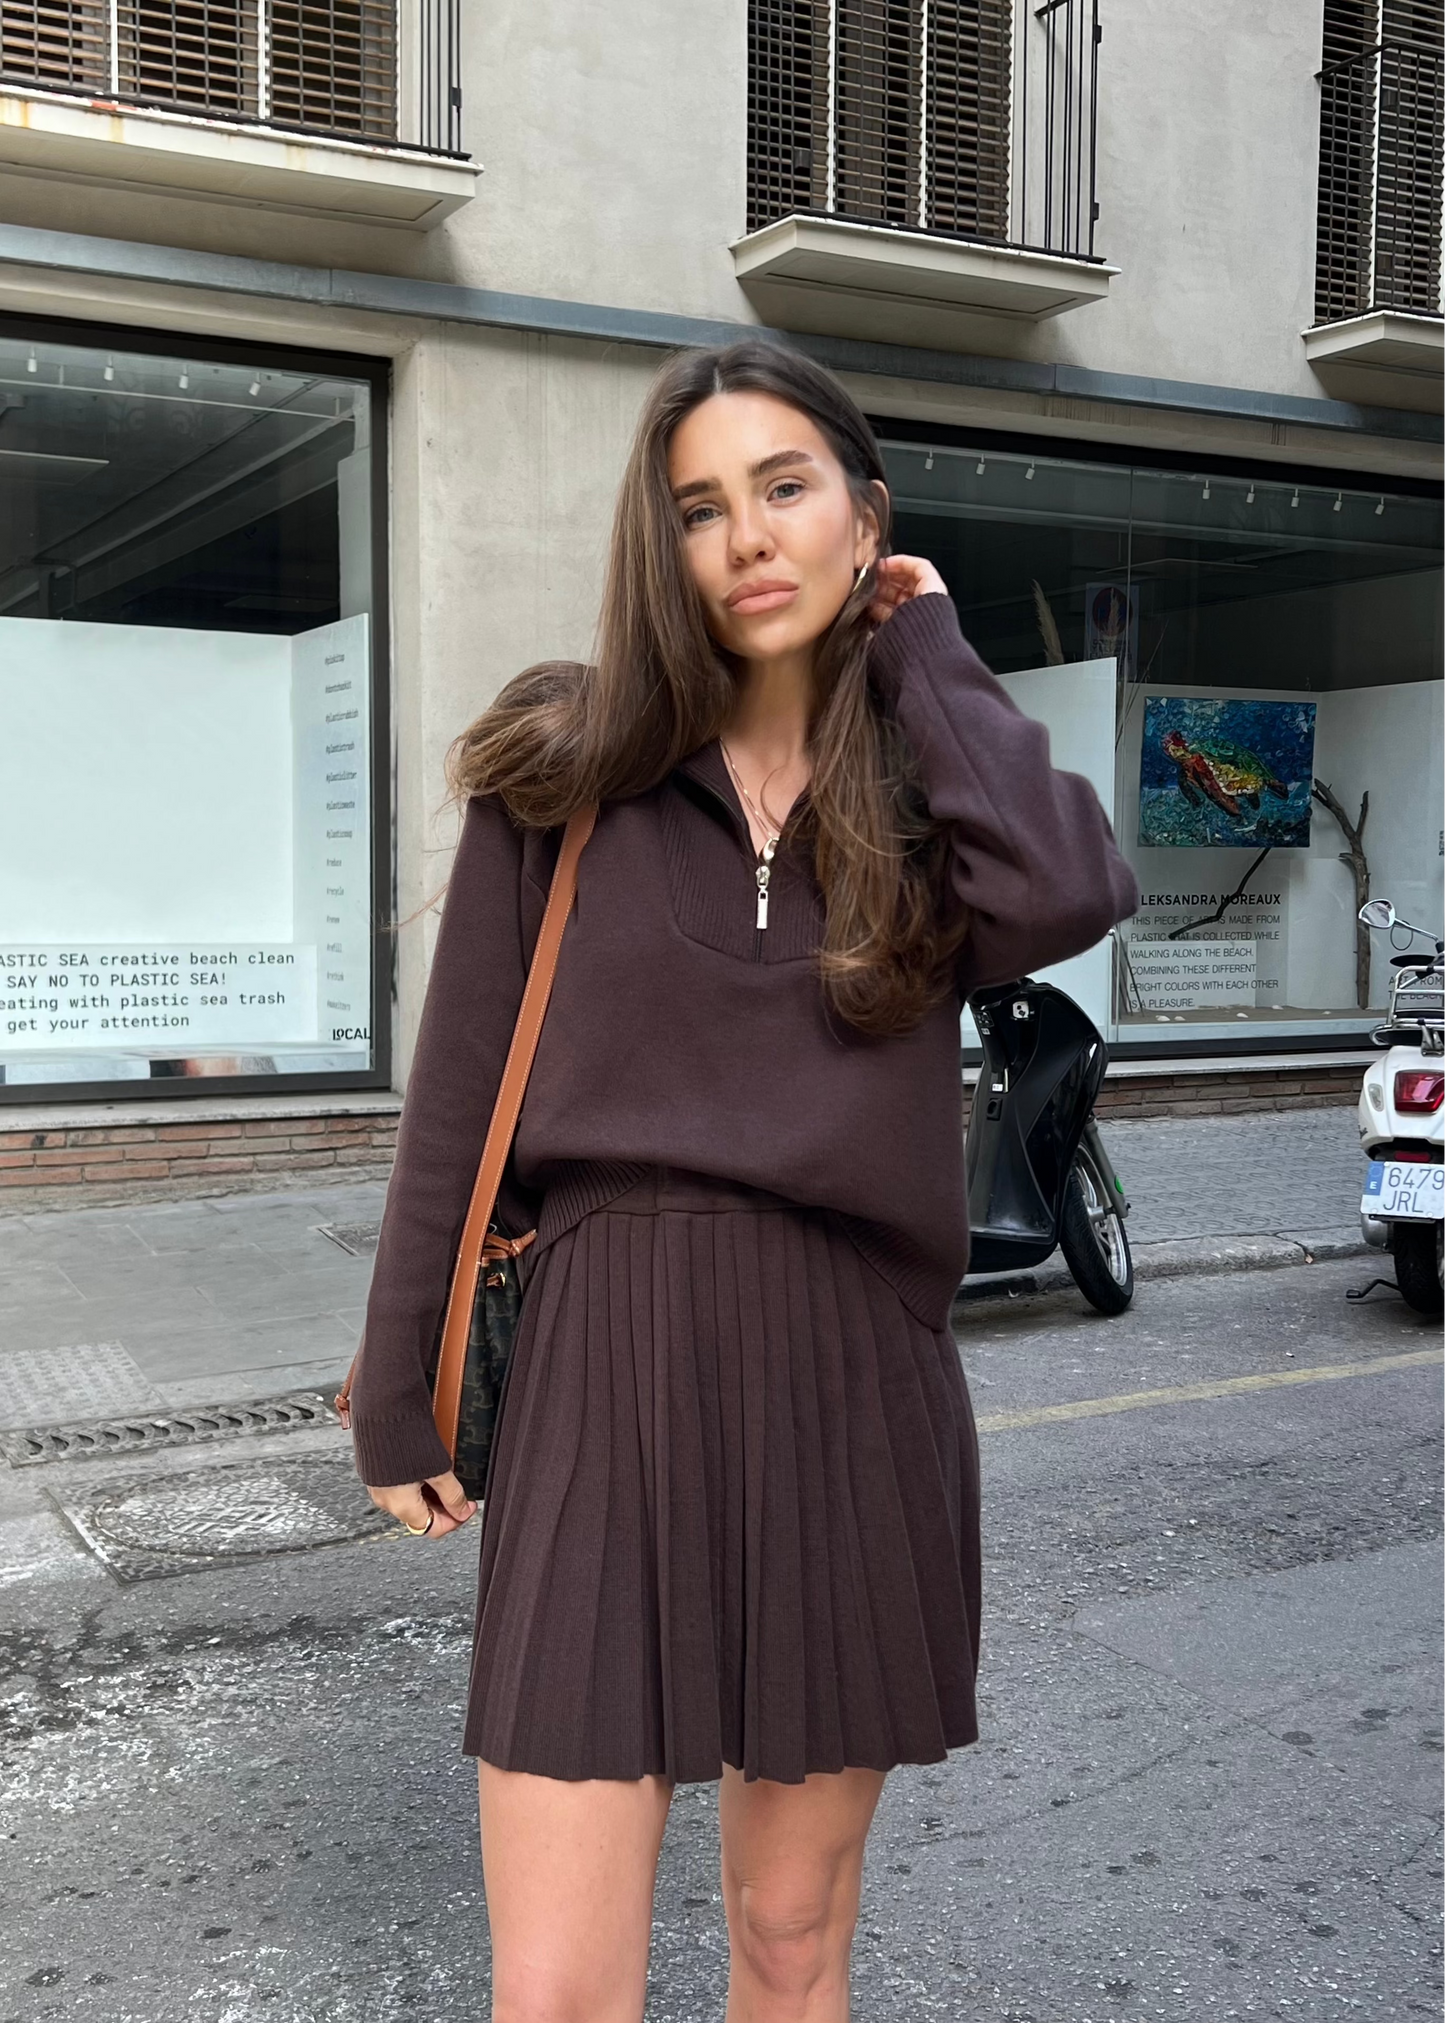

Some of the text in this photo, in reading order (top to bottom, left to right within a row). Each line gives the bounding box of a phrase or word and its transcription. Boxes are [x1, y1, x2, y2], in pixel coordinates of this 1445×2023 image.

[1141, 893, 1281, 906] LEKSANDRA MOREAUX
[1131, 916, 1151, 925] THIS
[1154, 916, 1179, 925] PIECE
[1182, 915, 1194, 924] OF
[1229, 915, 1253, 924] MADE
[1256, 915, 1280, 924] FROM
[1130, 932, 1166, 942] PLASTIC
[1193, 932, 1201, 941] IS
[1202, 931, 1252, 941] COLLECTED
[1254, 931, 1280, 940] WHILE
[59, 953, 89, 967] SEA
[100, 952, 179, 966] creative
[190, 952, 238, 965] beach
[248, 951, 295, 964] clean
[1130, 949, 1170, 959] WALKING
[1172, 948, 1202, 958] ALONG
[1204, 948, 1221, 957] THE
[1131, 964, 1257, 976] COMBINING THESE DIFFERENT
[7, 972, 226, 988] SAY NO TO PLASTIC SEA!
[1130, 980, 1279, 992] BRIGHT COLORS WITH EACH OTHER
[0, 991, 286, 1012] eating with plastic sea trash
[7, 1014, 190, 1034] get your attention
[1369, 1181, 1378, 1190] E
[1387, 1167, 1445, 1191] 6479
[1383, 1190, 1425, 1214] JRL
